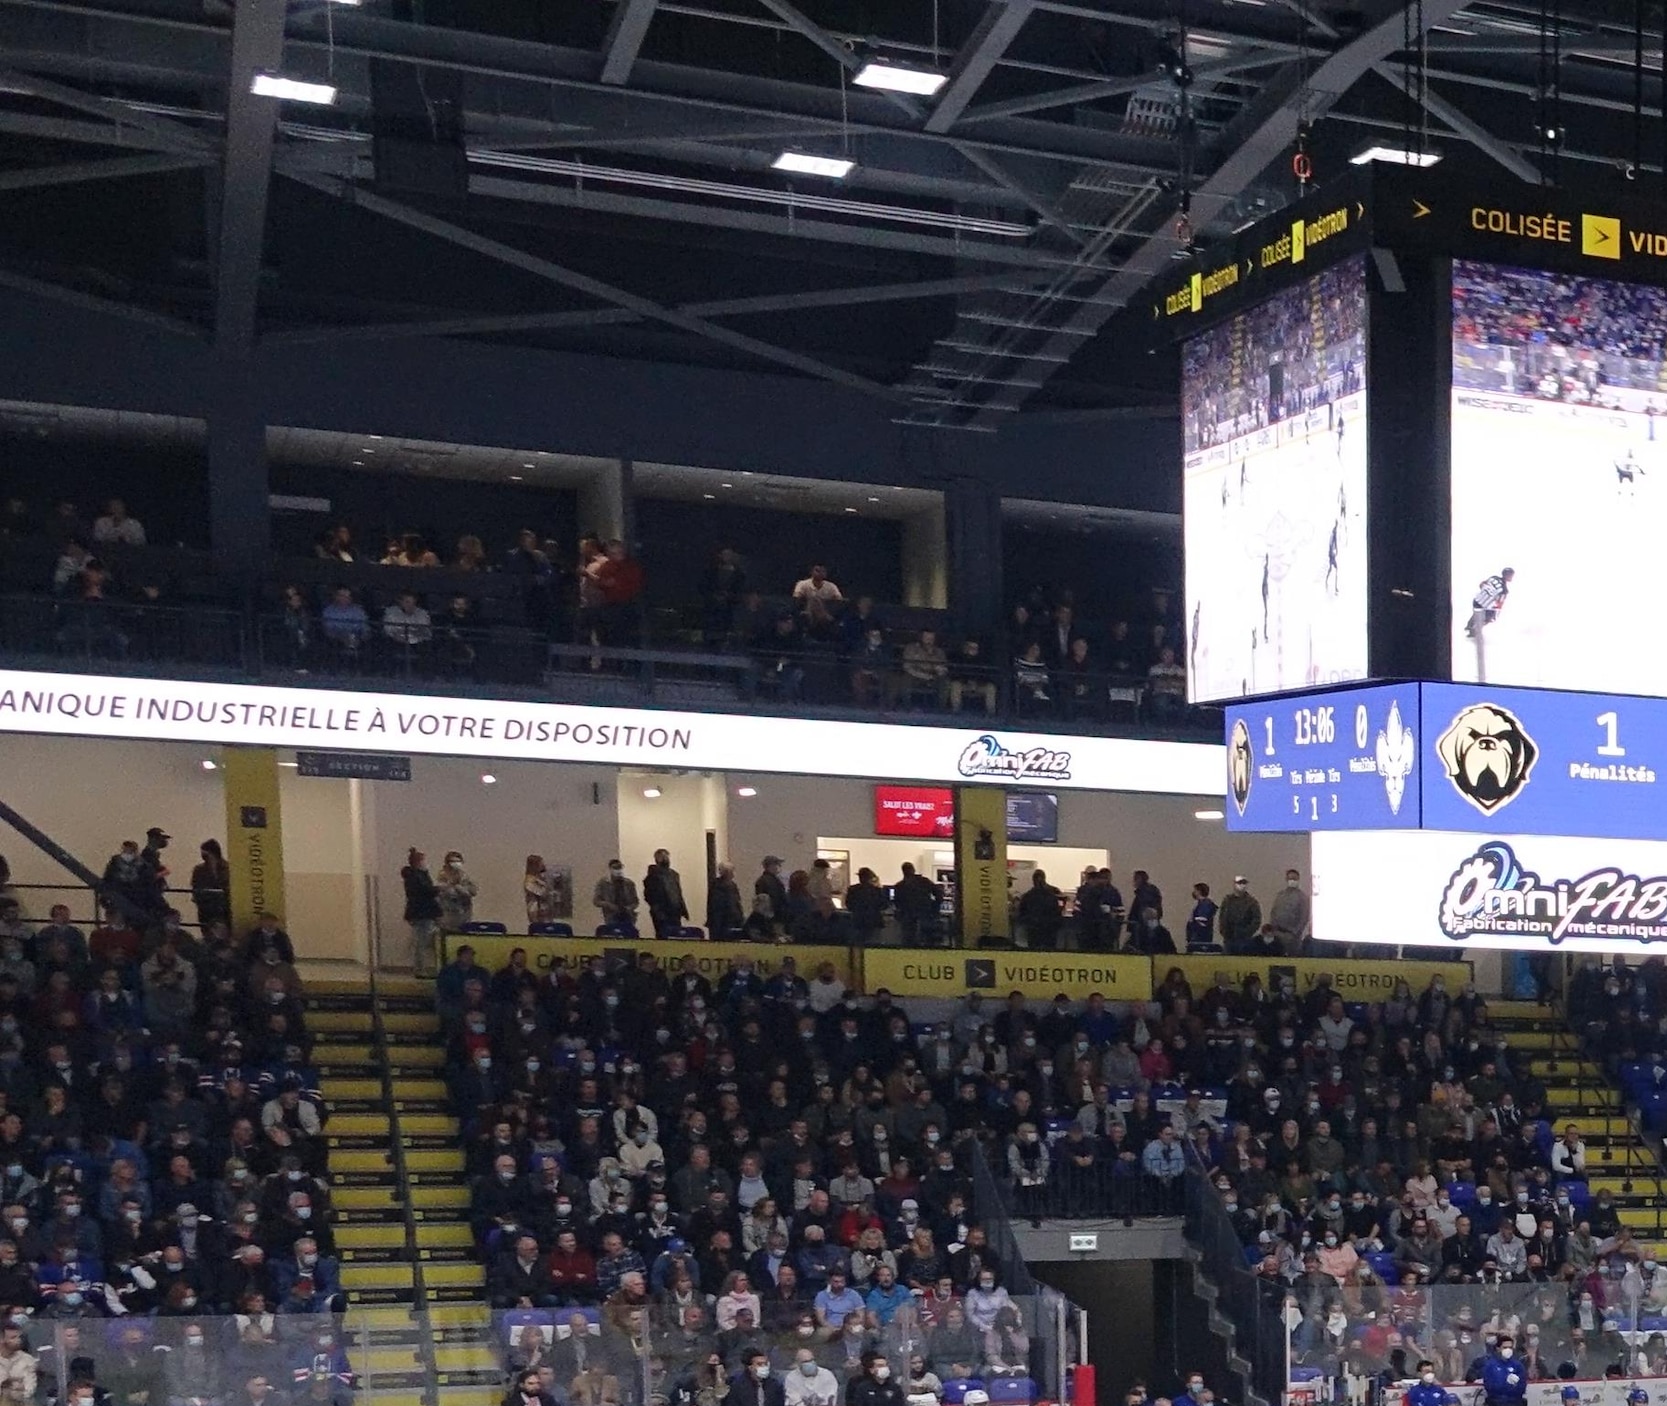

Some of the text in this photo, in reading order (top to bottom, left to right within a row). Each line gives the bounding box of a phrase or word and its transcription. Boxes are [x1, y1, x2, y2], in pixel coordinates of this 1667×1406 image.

[1471, 207, 1571, 243] COLISÉE
[136, 697, 361, 732] INDUSTRIELLE
[368, 707, 386, 733] À
[398, 713, 495, 739] VOTRE
[504, 719, 691, 750] DISPOSITION
[1265, 705, 1368, 756] 1 13:06 0
[1595, 711, 1626, 757] 1
[1569, 762, 1656, 784] Pénalités
[1311, 796, 1319, 821] 1
[1452, 916, 1553, 934] Fabrication
[903, 965, 1117, 984] CLUB VIDÉOTRON
